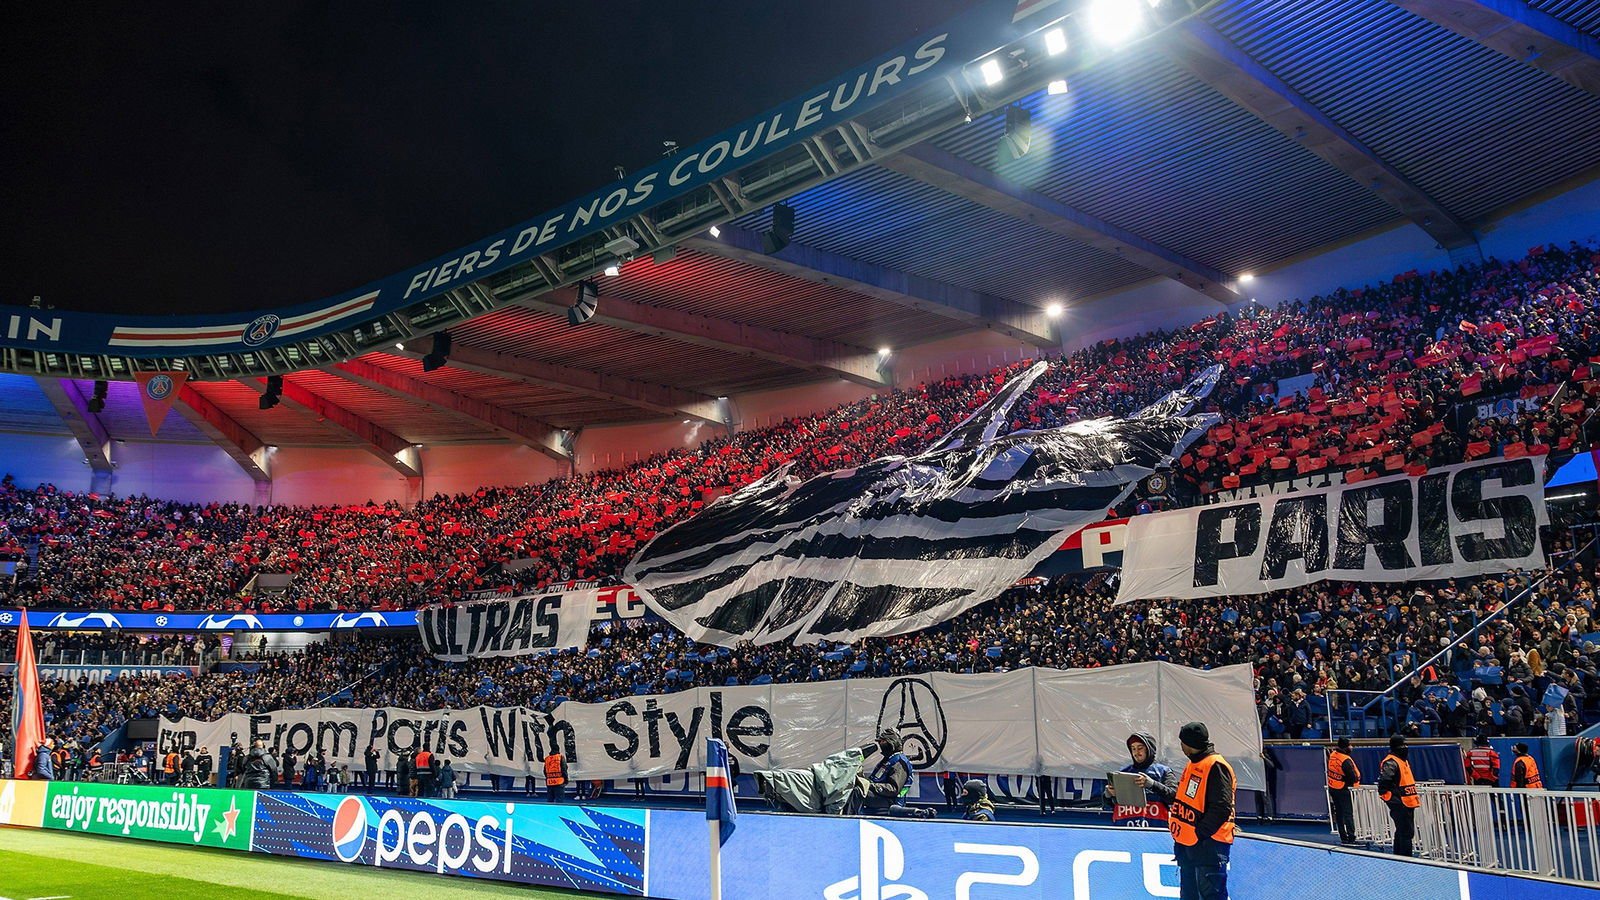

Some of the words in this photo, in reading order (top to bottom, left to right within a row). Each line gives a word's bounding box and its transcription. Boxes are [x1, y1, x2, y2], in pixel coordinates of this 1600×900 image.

[403, 239, 507, 299] FIERS
[509, 214, 563, 256] DE
[568, 172, 658, 233] NOS
[668, 33, 949, 186] COULEURS
[0, 315, 62, 341] IN
[1193, 458, 1538, 588] PARIS
[422, 595, 564, 656] ULTRAS
[250, 715, 358, 758] From
[370, 709, 469, 758] Paris
[480, 706, 578, 763] With
[604, 691, 774, 769] Style
[51, 786, 97, 830] enjoy
[97, 791, 211, 843] responsibly
[375, 803, 514, 874] pepsi
[1118, 805, 1159, 817] PHOTO
